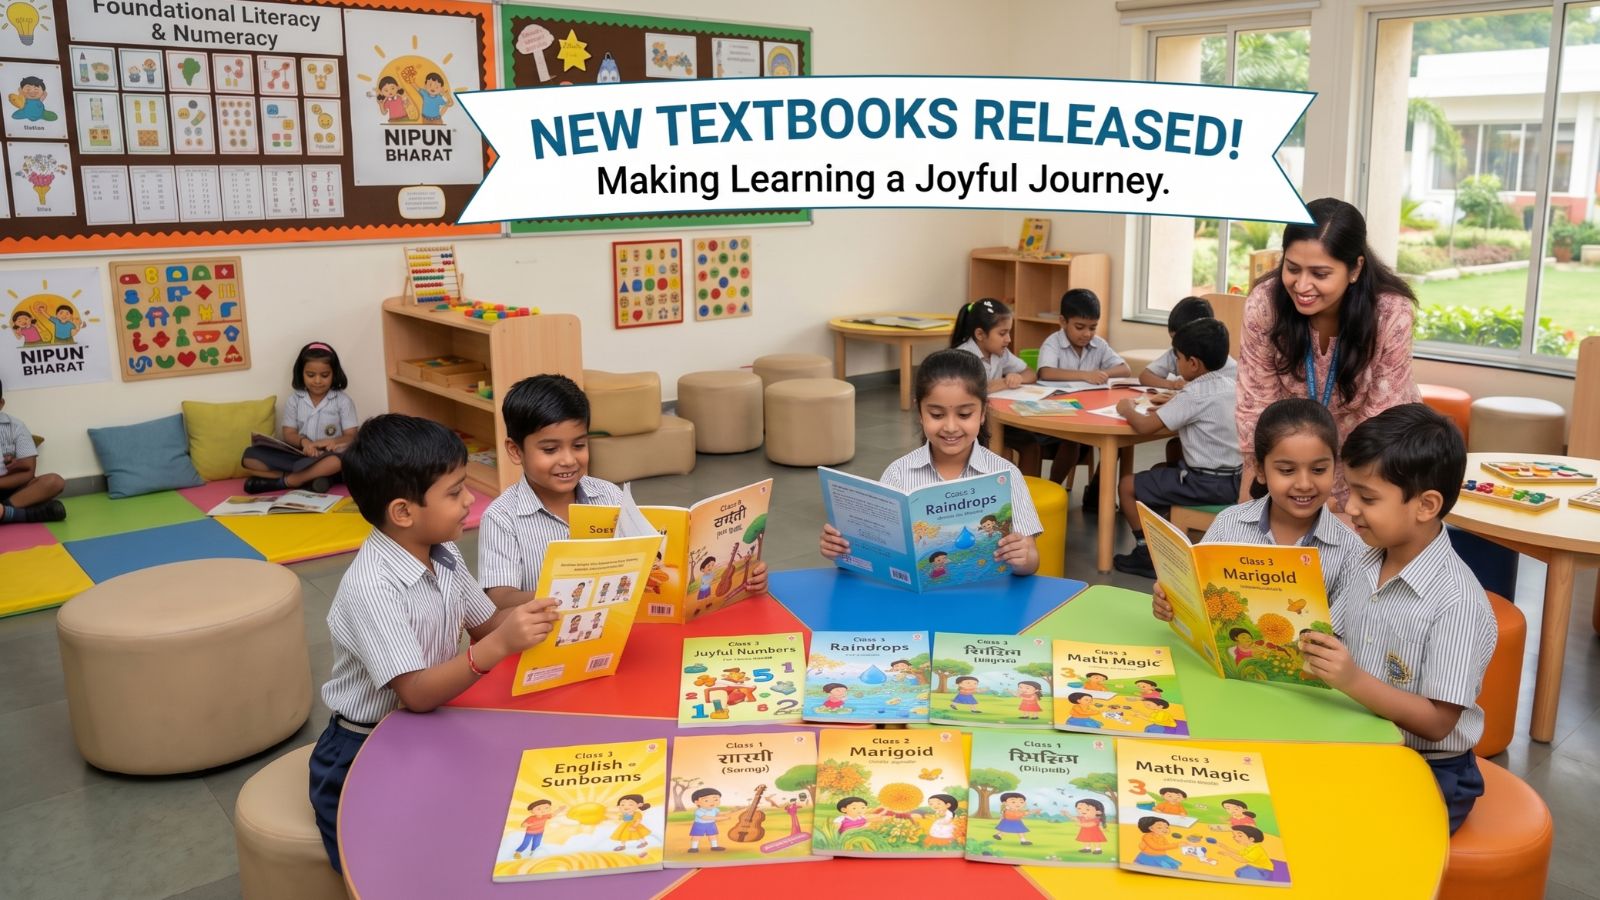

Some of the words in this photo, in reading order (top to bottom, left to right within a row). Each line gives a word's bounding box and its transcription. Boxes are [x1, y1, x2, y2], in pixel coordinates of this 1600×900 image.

[93, 0, 236, 22] Foundational
[242, 6, 321, 31] Literacy
[151, 23, 167, 41] &
[173, 24, 279, 50] Numeracy
[385, 129, 452, 146] NIPUN
[386, 149, 453, 161] BHARAT
[20, 346, 84, 364] NIPUN
[23, 361, 85, 376] BHARAT
[926, 495, 997, 516] Raindrops
[1239, 556, 1265, 566] Class
[1268, 558, 1274, 566] 3
[1223, 567, 1297, 585] Marigold
[830, 643, 910, 653] Raindrops
[1067, 653, 1108, 664] Math
[1113, 657, 1161, 668] Magic
[1023, 740, 1052, 748] Class
[1171, 754, 1200, 763] Class
[554, 760, 623, 775] English
[1135, 760, 1185, 775] Math
[1191, 766, 1250, 782] Magic
